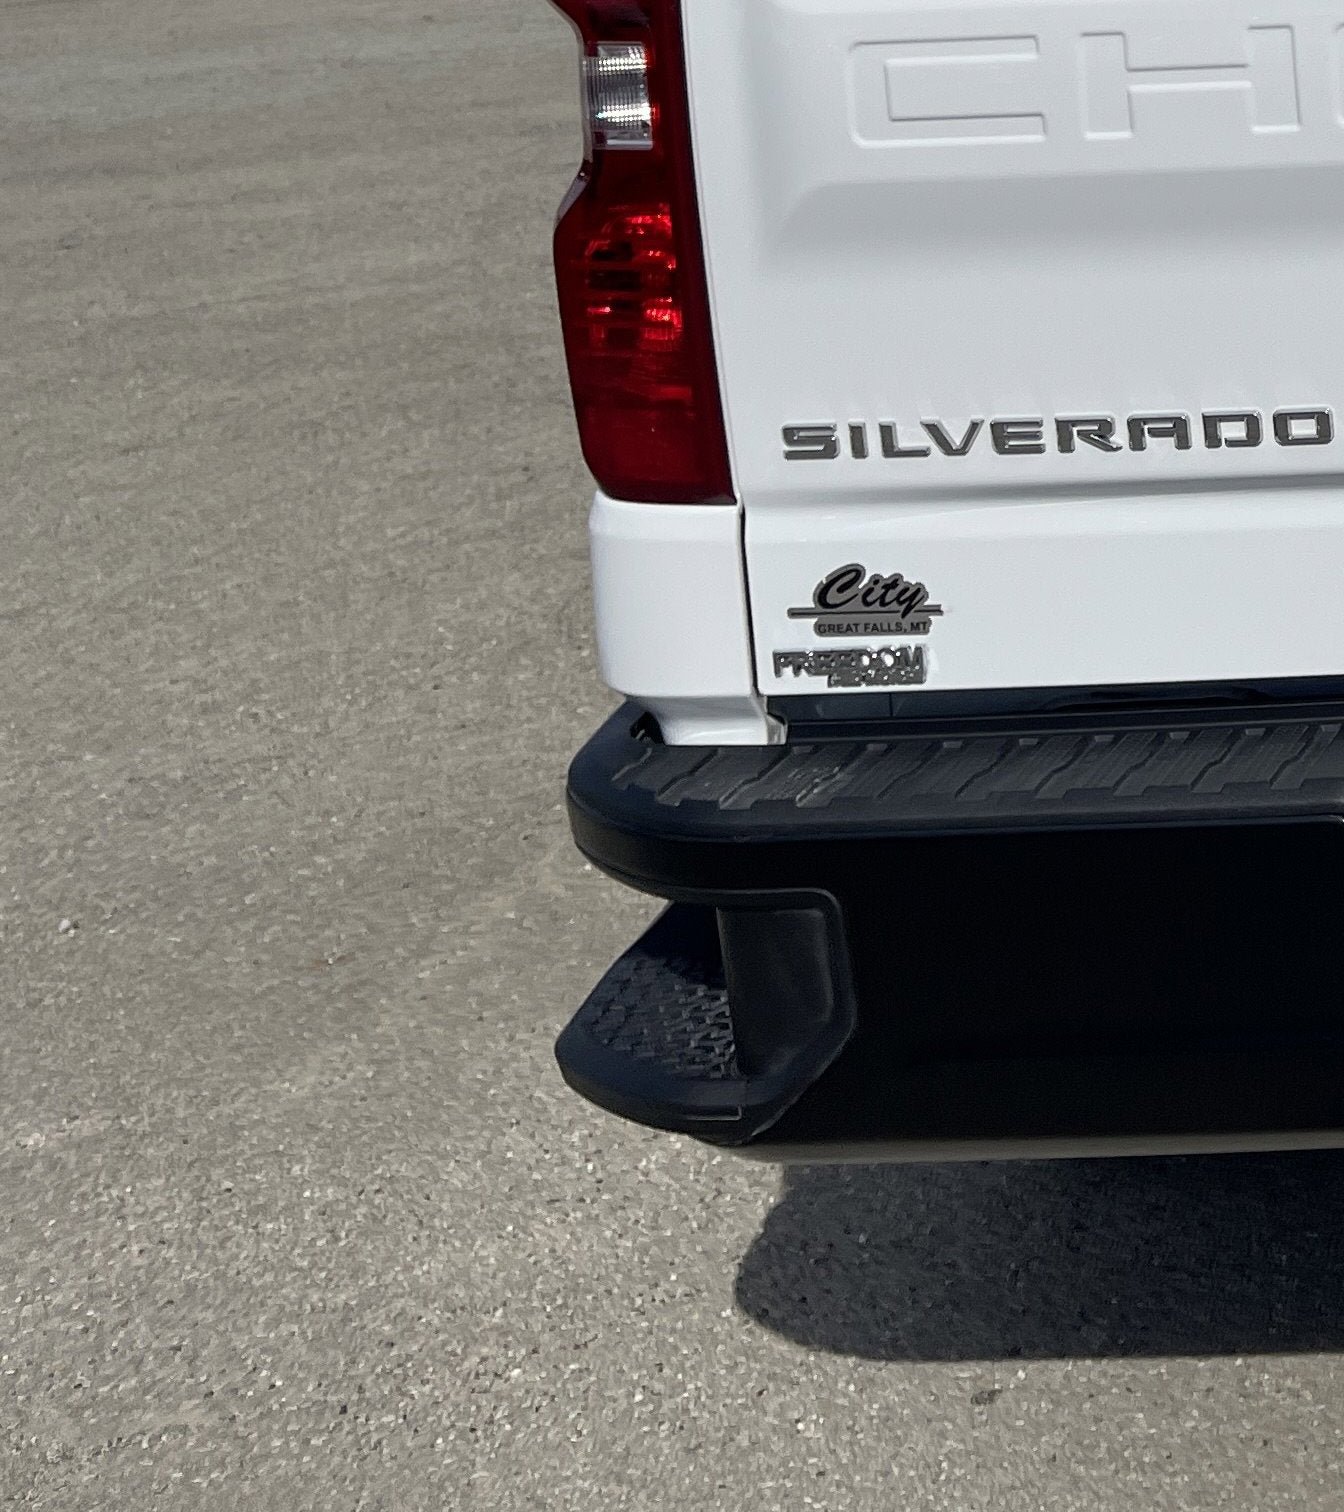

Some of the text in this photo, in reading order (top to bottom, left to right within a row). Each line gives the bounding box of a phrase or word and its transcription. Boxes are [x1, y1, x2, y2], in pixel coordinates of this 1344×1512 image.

[780, 406, 1337, 461] SILVERADO
[817, 568, 925, 619] City
[817, 621, 928, 634] GREAT FALLS, MT
